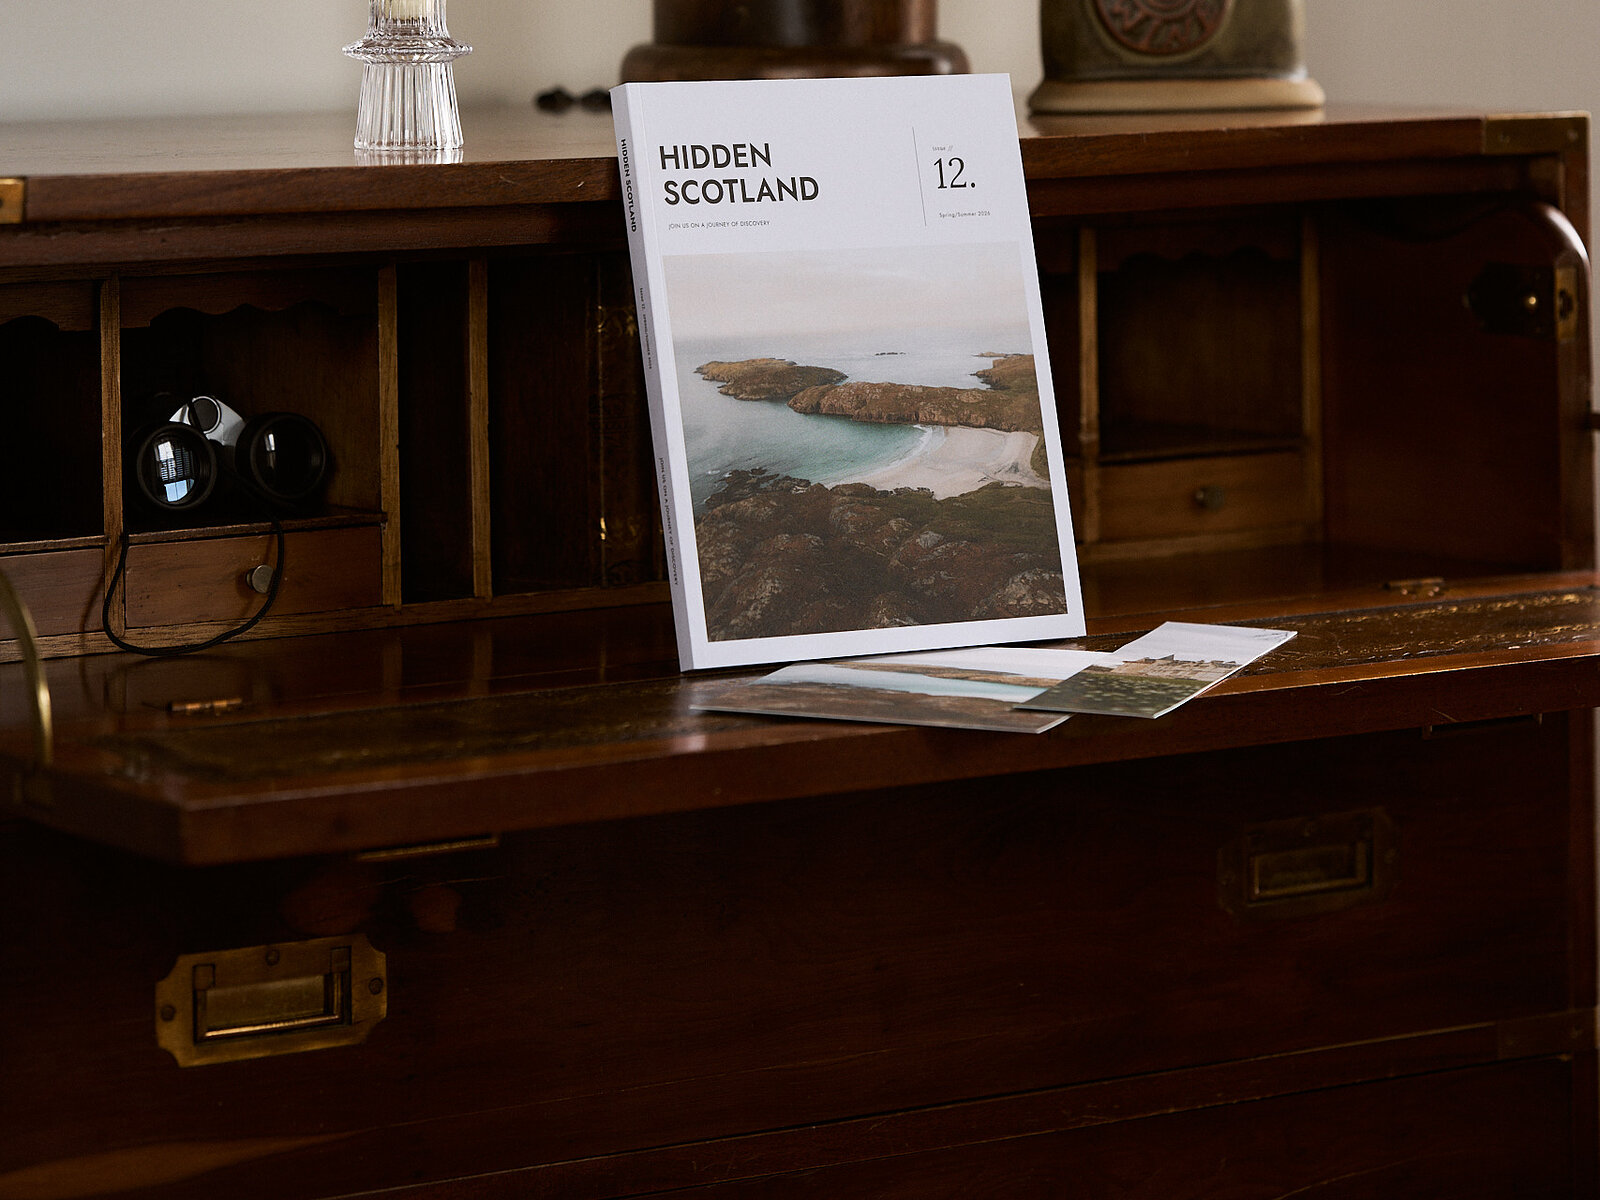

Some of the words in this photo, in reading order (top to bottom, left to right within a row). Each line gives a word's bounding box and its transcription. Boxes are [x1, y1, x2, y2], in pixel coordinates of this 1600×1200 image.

[659, 143, 772, 169] HIDDEN
[621, 139, 631, 177] HIDDEN
[626, 179, 637, 232] SCOTLAND
[933, 157, 976, 189] 12.
[664, 177, 819, 205] SCOTLAND
[669, 222, 681, 230] JOIN
[706, 221, 730, 229] JOURNEY
[664, 505, 672, 535] JOURNEY
